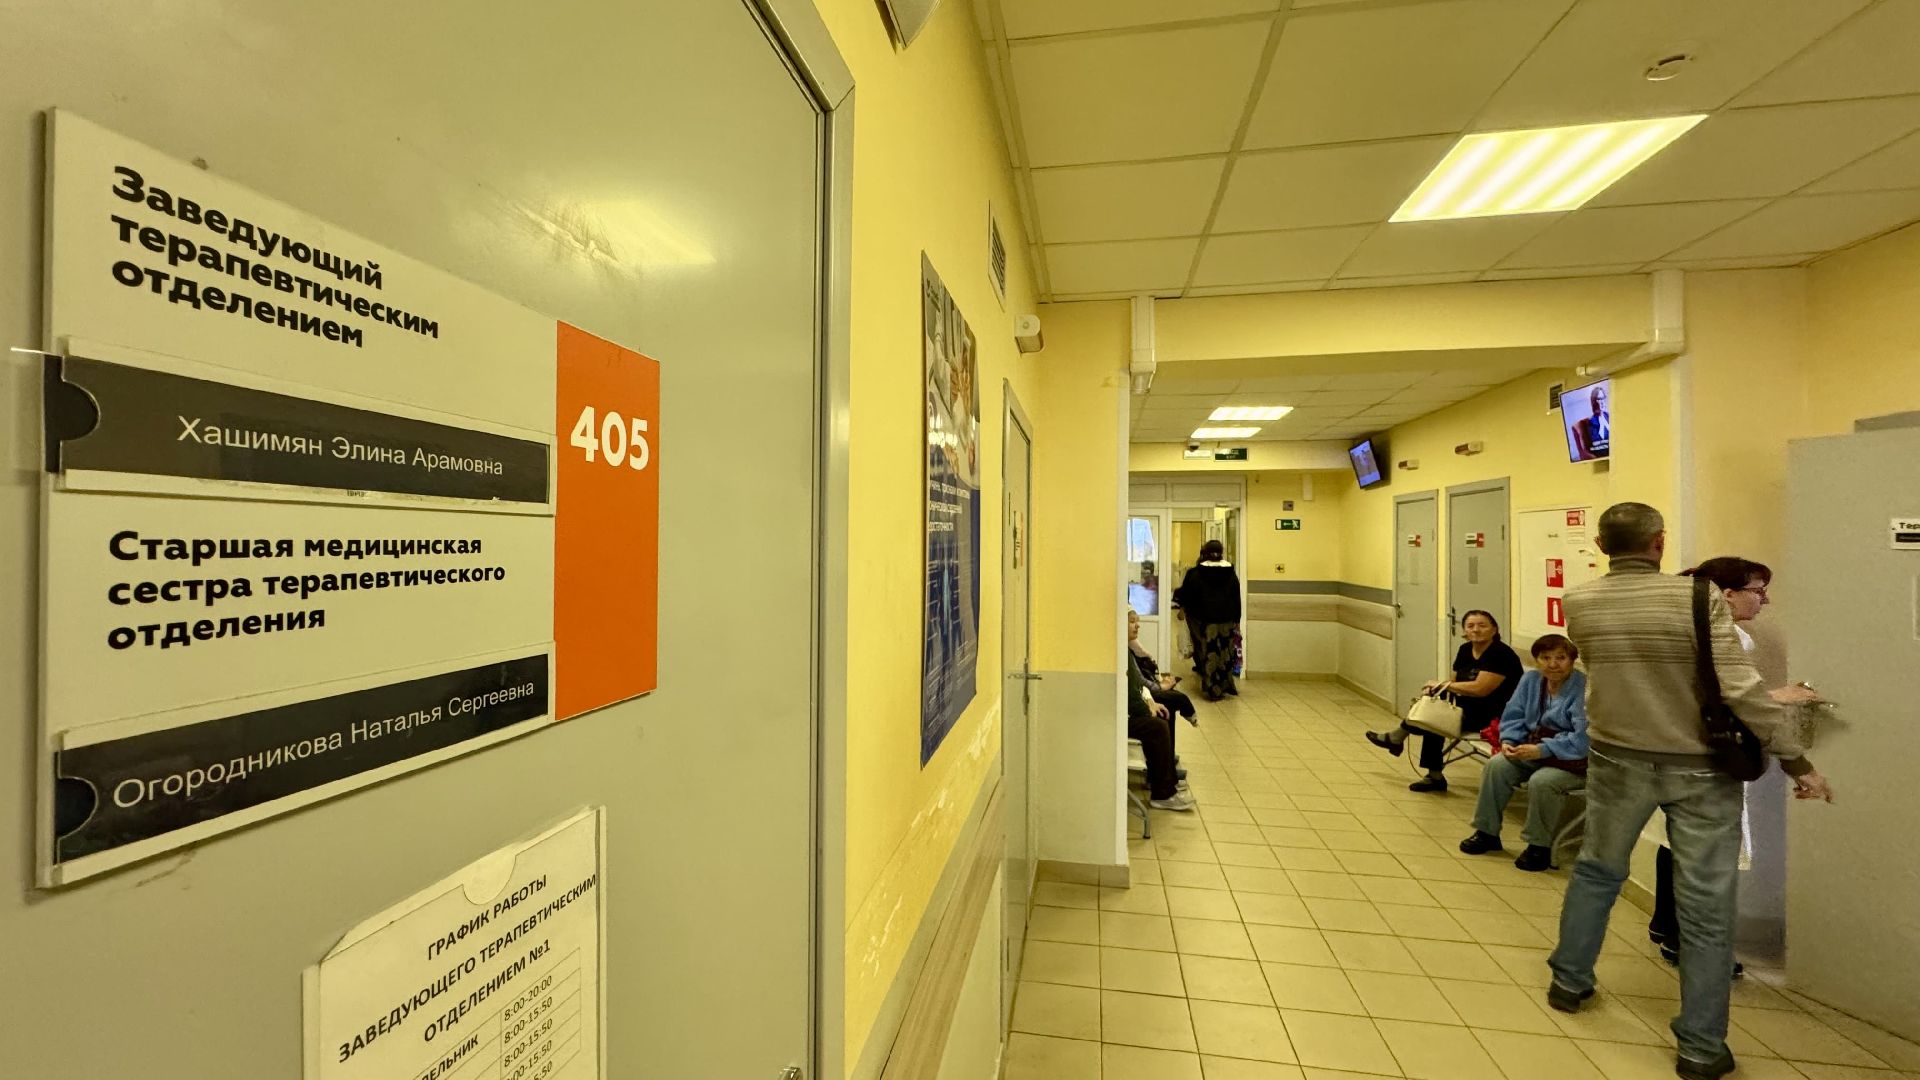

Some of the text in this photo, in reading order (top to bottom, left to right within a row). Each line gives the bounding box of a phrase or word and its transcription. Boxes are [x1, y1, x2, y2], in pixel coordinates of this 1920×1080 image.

[112, 166, 382, 291] Заведующий
[110, 214, 439, 339] терапевтическим
[112, 260, 363, 348] отделением
[177, 415, 503, 475] Хашимян Элина Арамовна
[570, 405, 649, 471] 405
[109, 530, 482, 567] Старшая медицинская
[108, 563, 506, 607] сестра терапевтического
[107, 609, 325, 650] отделения
[113, 682, 534, 808] Огородникова Наталья Сергеевна
[427, 874, 547, 960] ГРАФИК РАБОТЫ
[338, 874, 596, 1064] ЗАВЕДУЮЩЕГО ТЕРАПЕВТИЧЕСКИМ
[424, 939, 551, 1042] ОТДЕЛЕНИЕМ №1
[504, 975, 552, 1021] 8:00-20:00
[504, 996, 553, 1044] 8:00-15:50
[504, 1018, 553, 1067] 8:00-15:50
